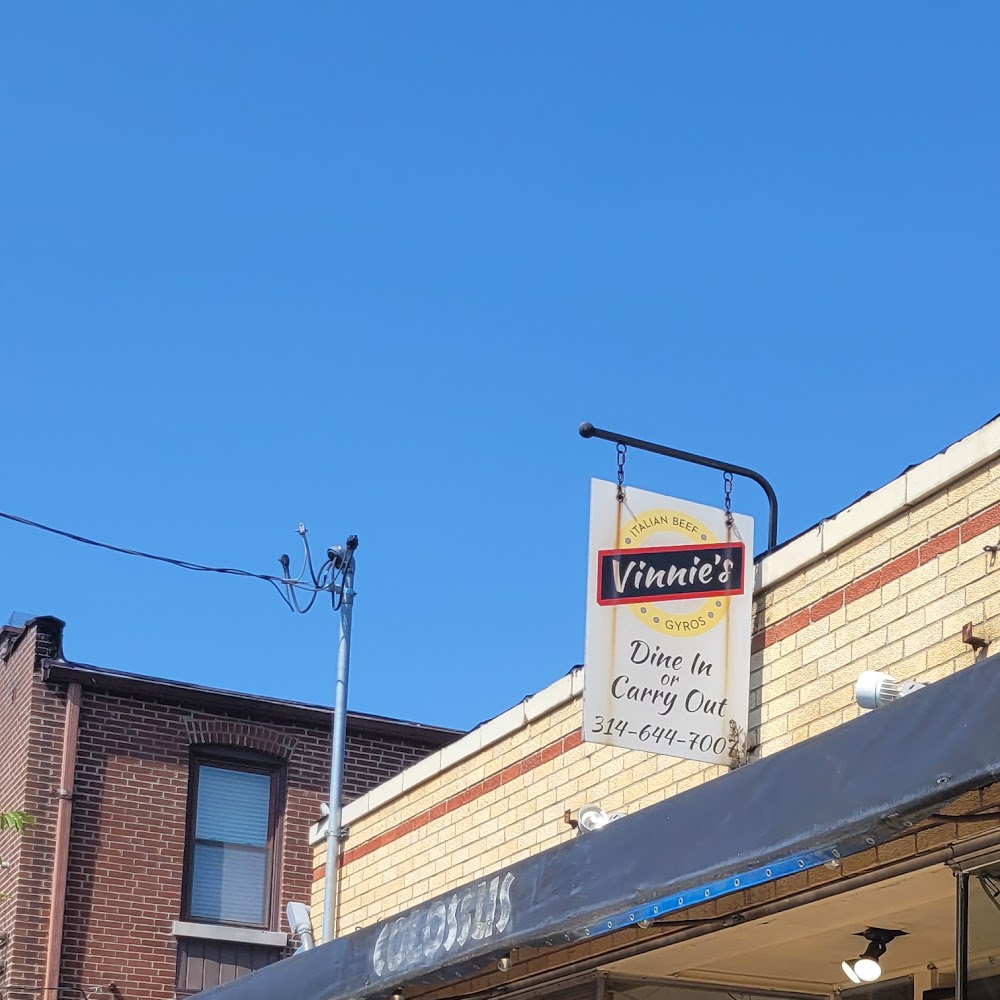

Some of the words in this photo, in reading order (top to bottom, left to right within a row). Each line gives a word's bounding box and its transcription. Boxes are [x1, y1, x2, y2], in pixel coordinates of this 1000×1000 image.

[629, 515, 668, 538] ITALIAN
[672, 516, 699, 535] BEEF
[612, 554, 733, 594] Vinnie's
[664, 616, 706, 632] GYROS
[630, 639, 683, 672] Dine
[691, 652, 713, 677] In
[661, 672, 680, 687] or
[611, 674, 679, 716] Carry
[684, 689, 728, 718] Out
